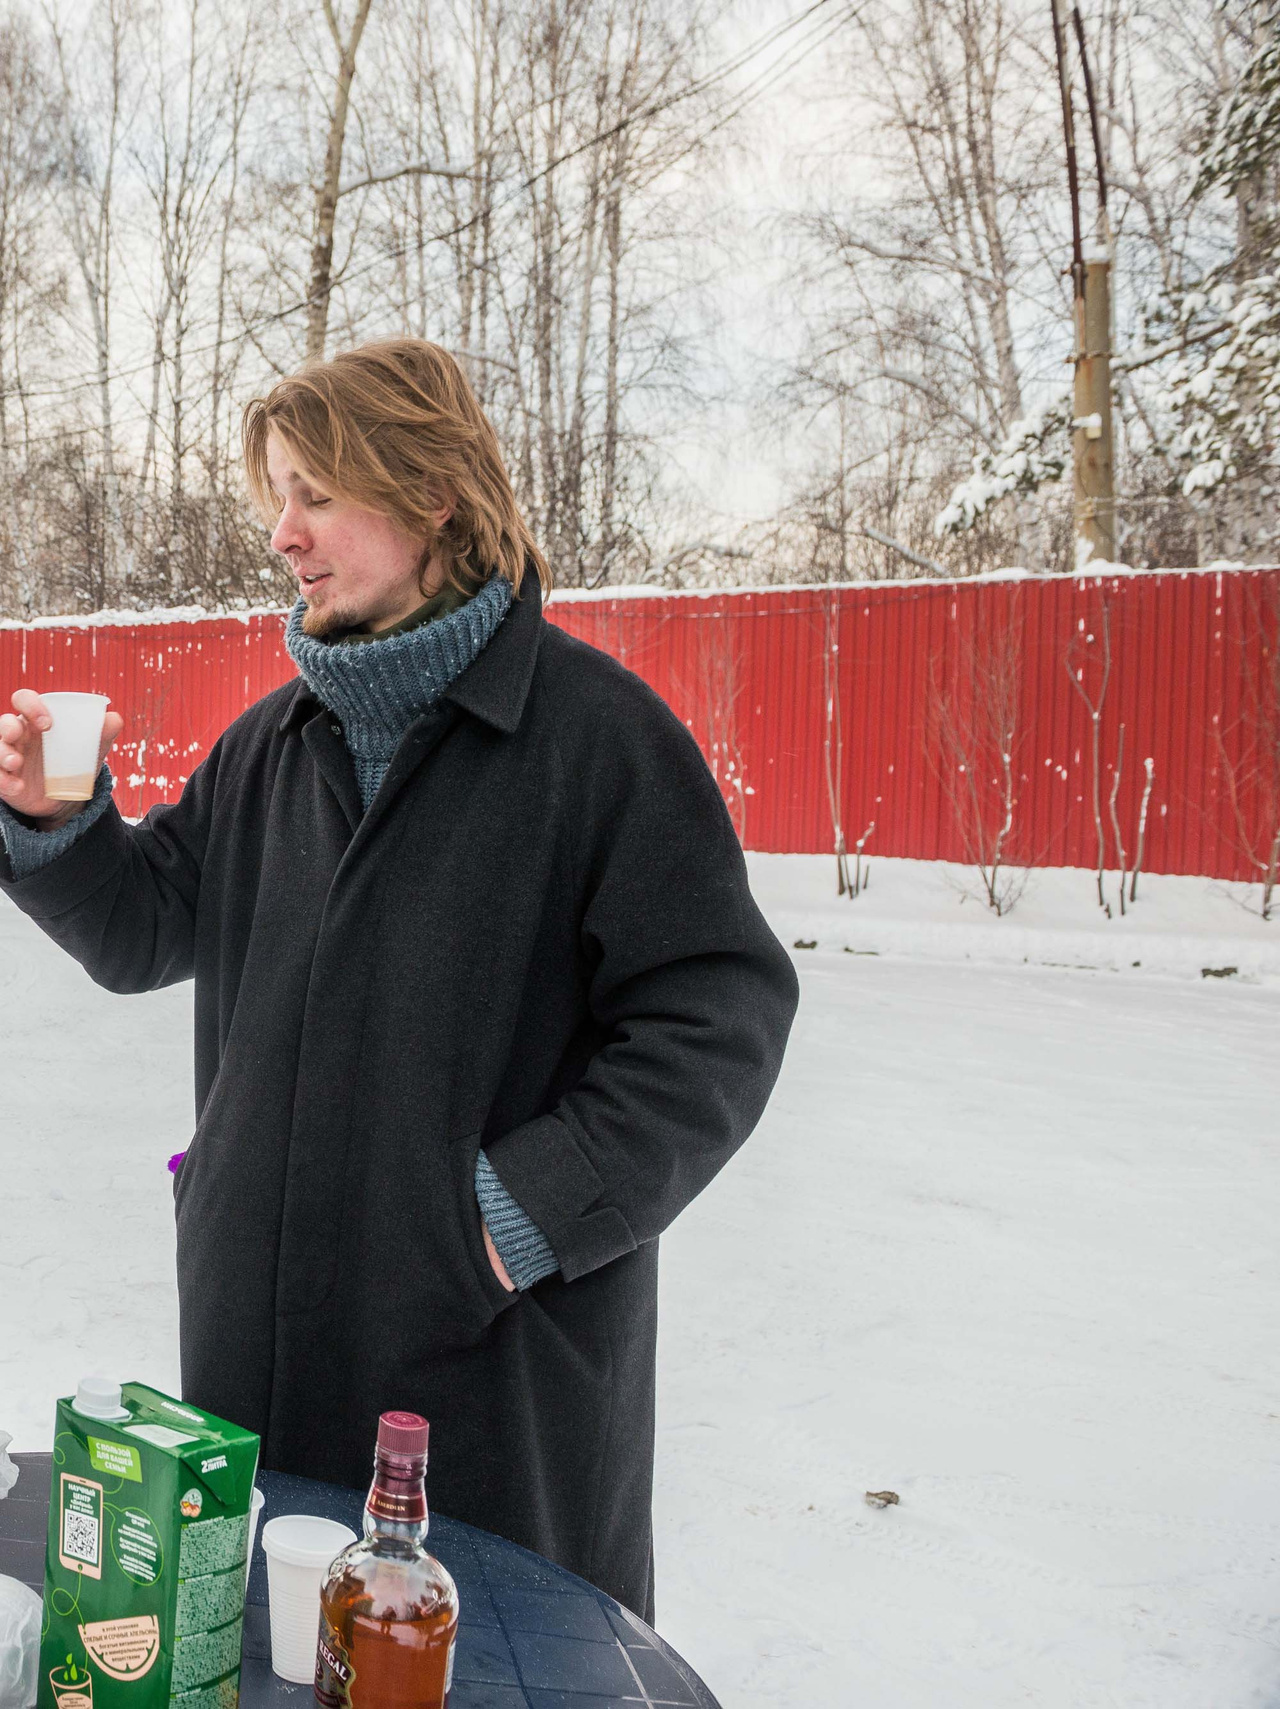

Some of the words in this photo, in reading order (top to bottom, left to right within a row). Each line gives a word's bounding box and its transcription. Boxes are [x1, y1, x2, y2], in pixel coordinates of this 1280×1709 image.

[101, 1443, 131, 1457] ПОЛЬЗОЙ
[104, 1461, 126, 1474] СЕМЬИ
[110, 1454, 133, 1467] ВАШЕЙ
[201, 1460, 208, 1474] 2
[207, 1459, 228, 1473] ЛИТРА
[68, 1483, 96, 1497] НАУЧНЫЙ
[73, 1492, 91, 1503] ЦЕНТР
[83, 1635, 103, 1643] СПЕЛЫЕ
[108, 1632, 128, 1640] СОЧНЫЕ
[130, 1629, 157, 1637] АПЕЛЬСИНЫ
[319, 1639, 347, 1681] REGAL
